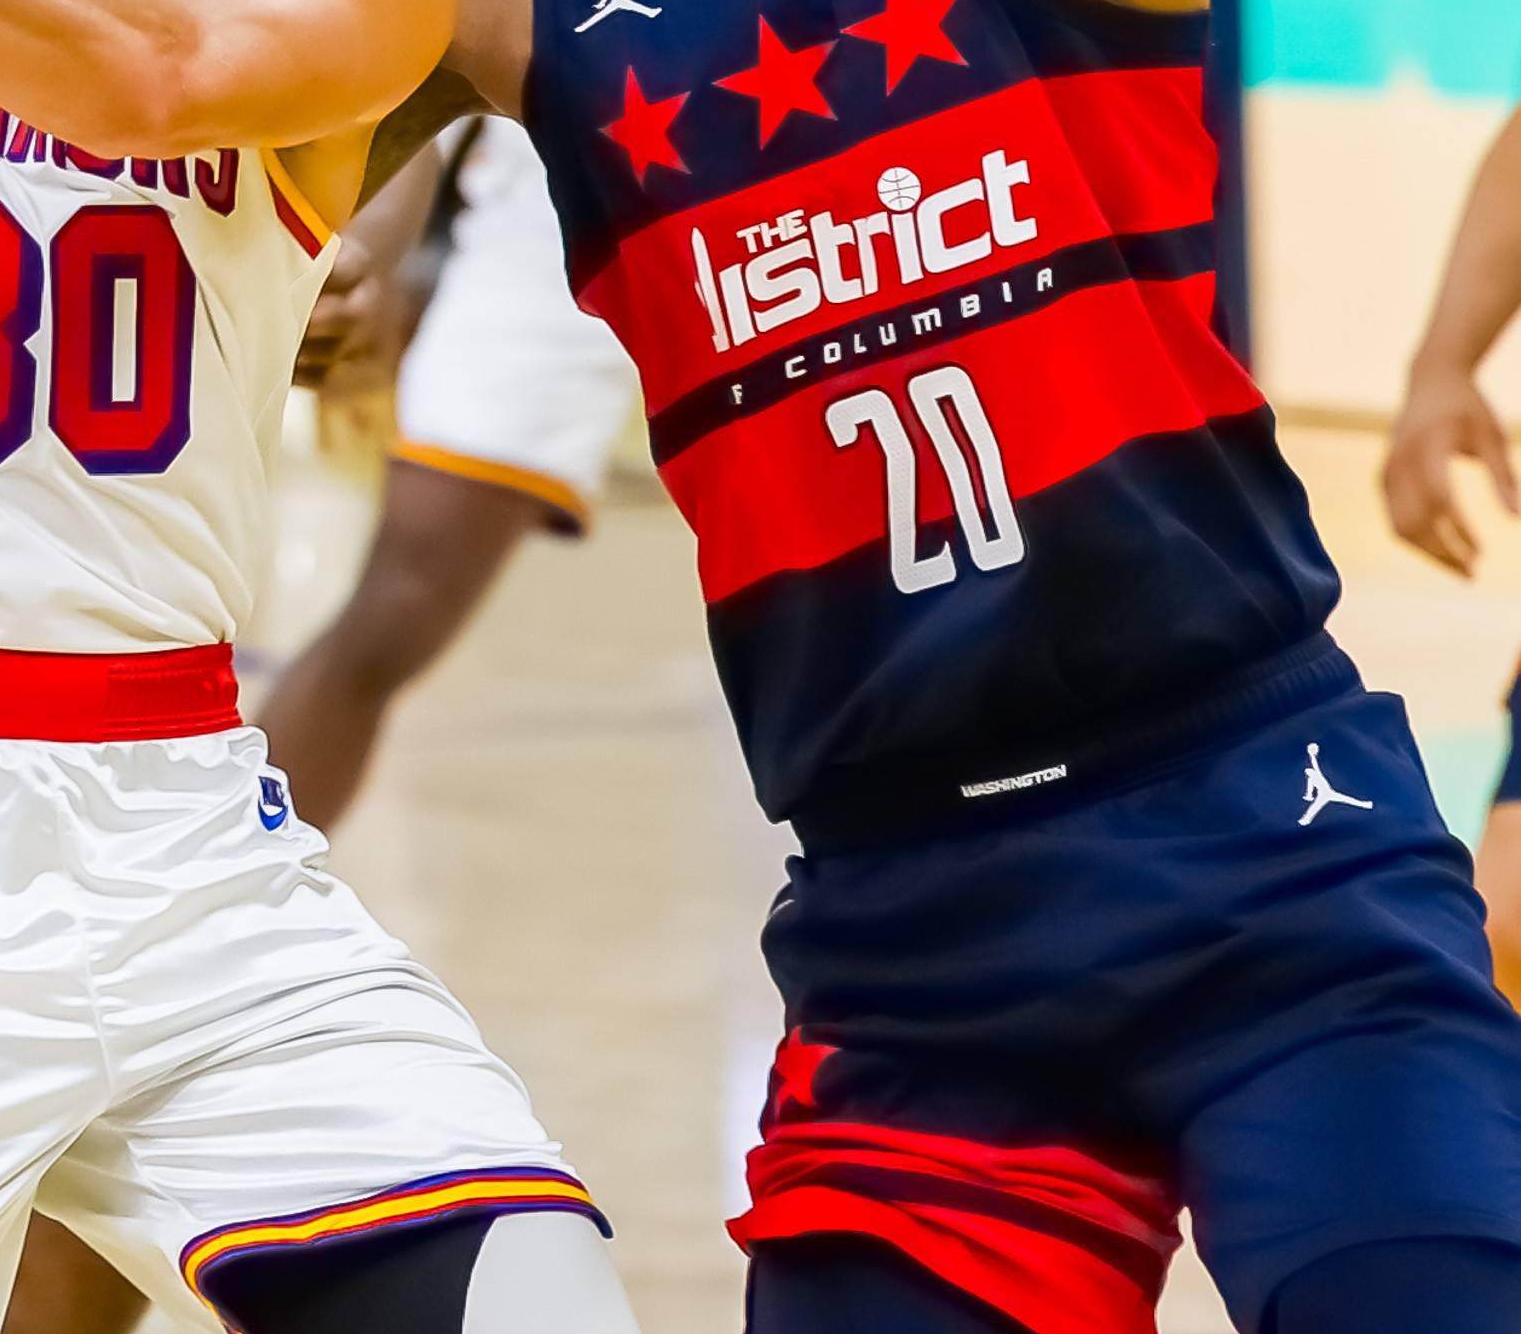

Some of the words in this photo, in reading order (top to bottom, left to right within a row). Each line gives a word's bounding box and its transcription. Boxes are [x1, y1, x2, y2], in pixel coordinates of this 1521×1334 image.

[736, 209, 808, 254] THE
[784, 267, 1053, 379] COLUMBIA
[826, 365, 1027, 595] 20
[960, 764, 1067, 798] WASHINGTON
